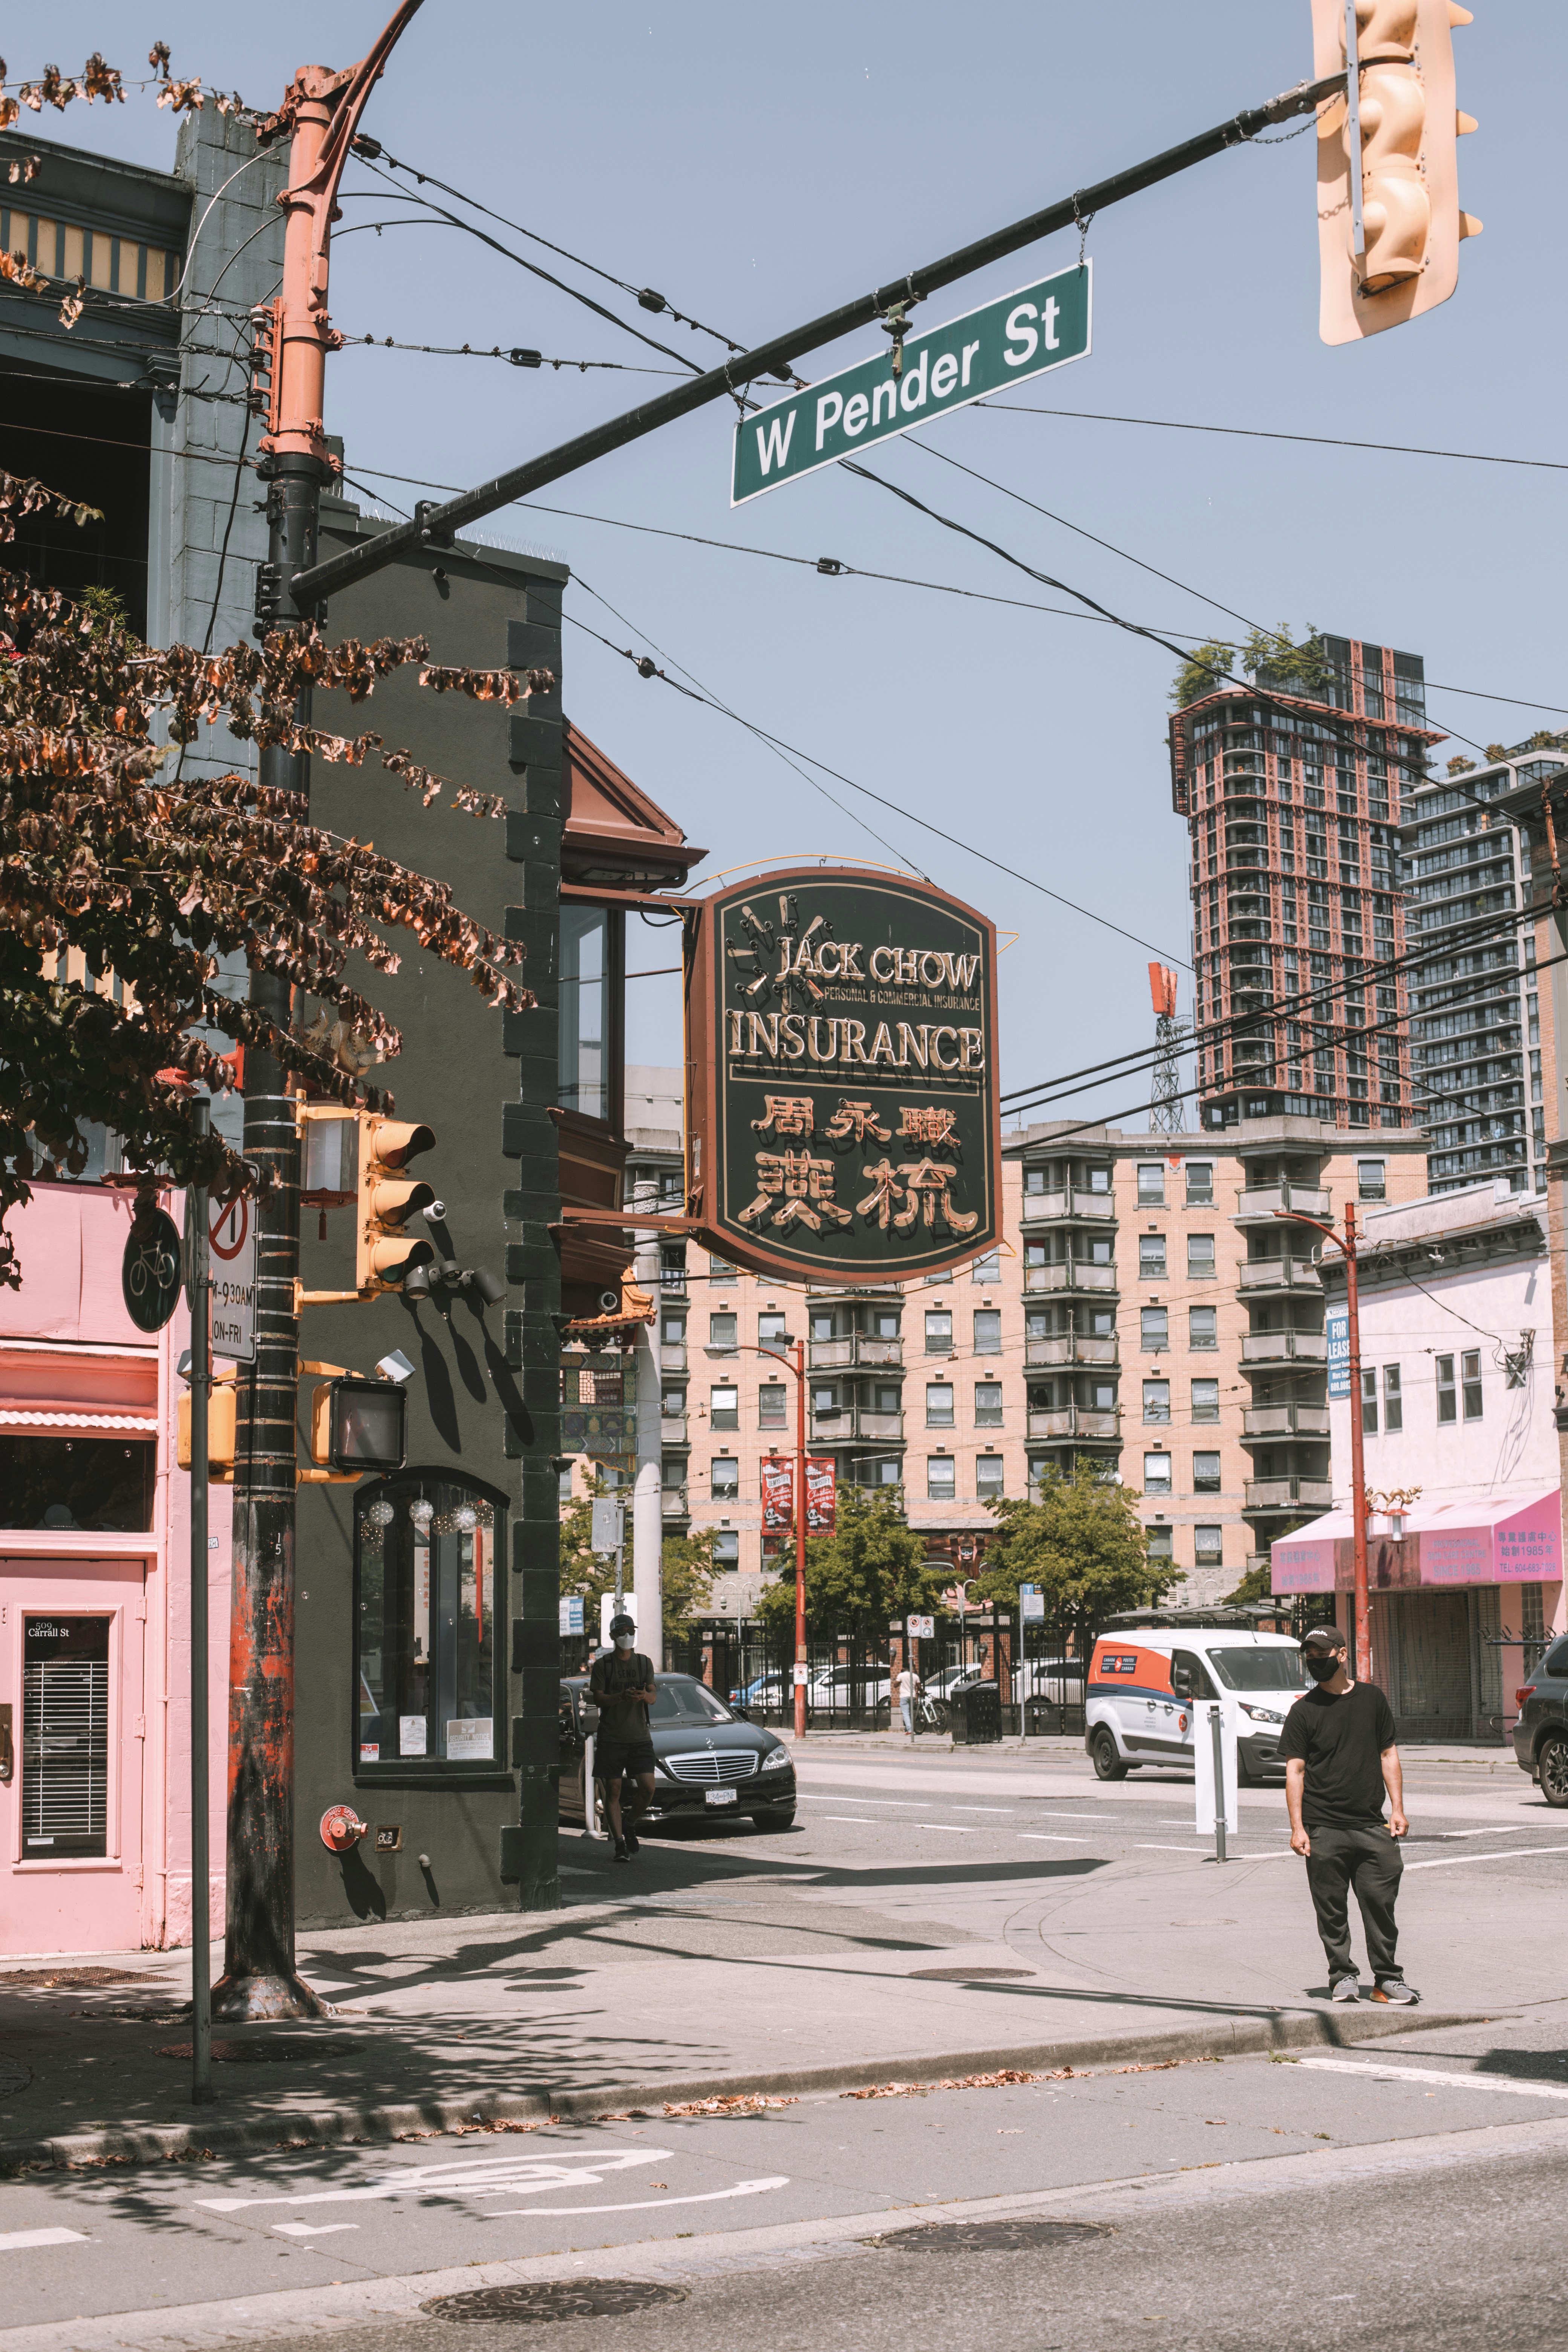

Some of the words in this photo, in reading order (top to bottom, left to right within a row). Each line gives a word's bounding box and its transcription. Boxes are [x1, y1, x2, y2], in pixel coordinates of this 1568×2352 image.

[756, 409, 796, 476] W
[815, 340, 979, 451] Pender
[1003, 296, 1060, 366] St
[775, 937, 866, 982] JACK
[870, 946, 980, 991] CHOW
[825, 986, 869, 1003] PERSONAL
[870, 989, 876, 1003] &
[877, 990, 933, 1008] COMMERCIAL
[934, 994, 980, 1011] INSURANCE
[729, 1011, 986, 1072] INSURANCE
[213, 1320, 241, 1344] ON-FRI
[1332, 1320, 1346, 1339] FOR
[769, 1476, 789, 1487] DEMYSTIFY
[810, 1477, 830, 1488] DEMYSTIFY
[765, 1486, 792, 1499] Chinatown
[807, 1488, 834, 1500] Chinatown
[1433, 1539, 1480, 1549] PROFESSIONAL
[1428, 1551, 1442, 1561] SKIN
[1443, 1550, 1460, 1560] CARE
[1461, 1550, 1486, 1559] CENTRE
[1433, 1565, 1458, 1577] SINCE
[1461, 1563, 1481, 1575] 1985
[1499, 1563, 1513, 1573] TEL:
[1515, 1563, 1556, 1573] 604-683-7028
[28, 1628, 58, 1637] Carrall
[60, 1628, 69, 1637] St
[35, 1622, 52, 1631] 509
[617, 1669, 636, 1678] SEND
[611, 1681, 640, 1691] NETWOR
[329, 1807, 341, 1817] AUTO
[343, 1808, 355, 1820] SPKR
